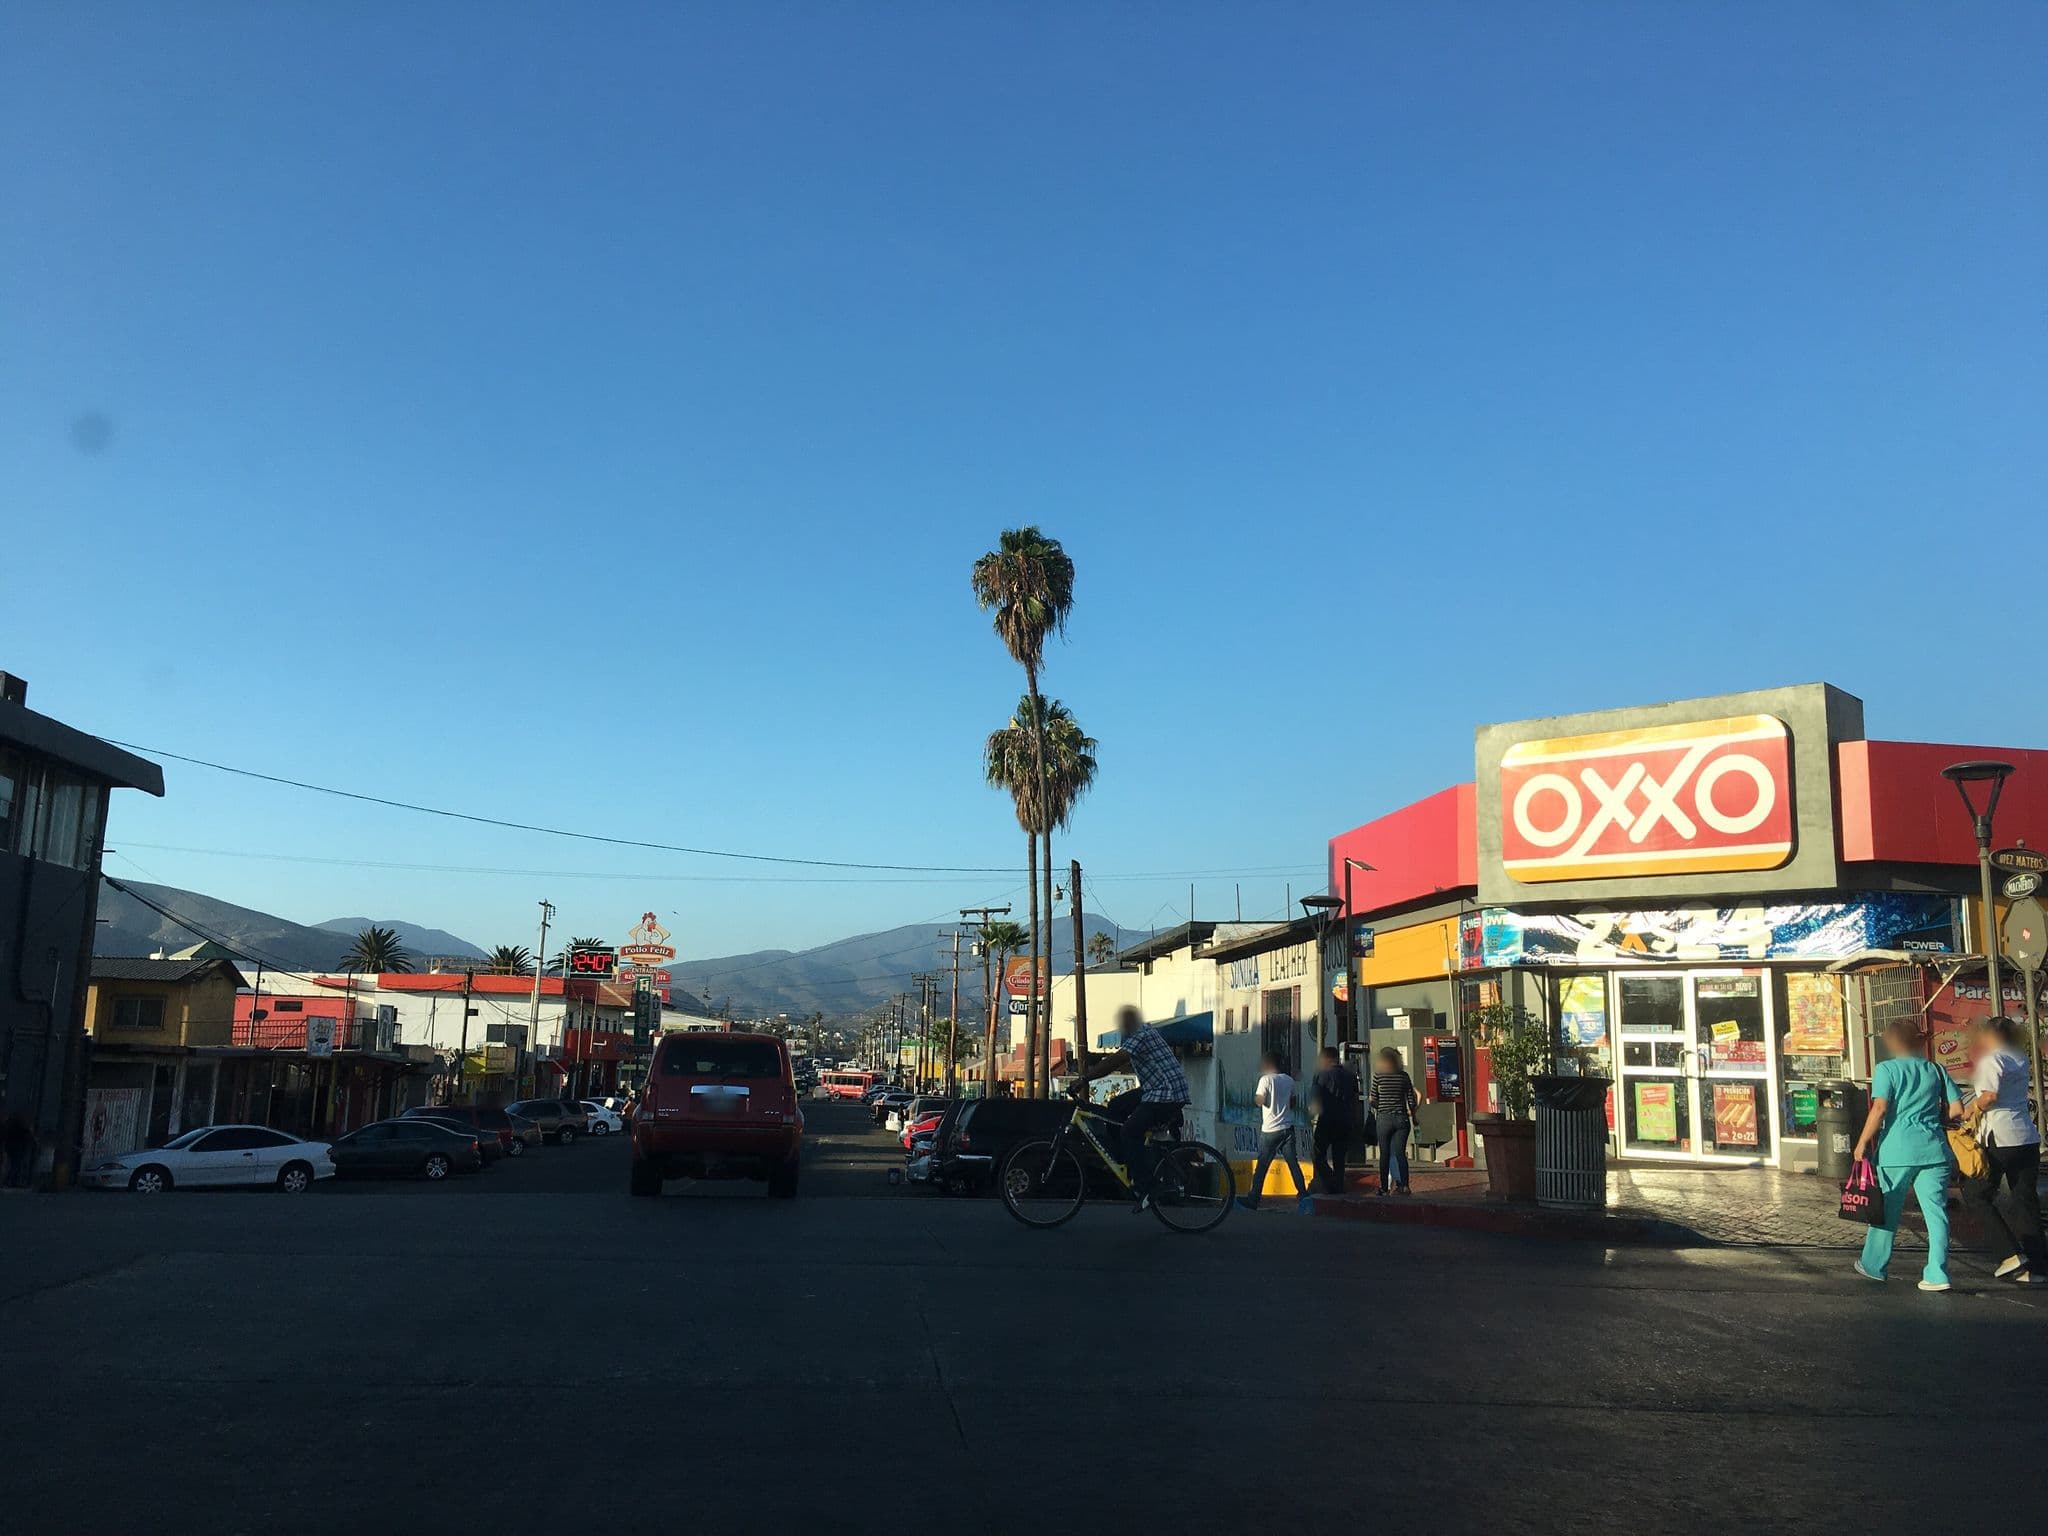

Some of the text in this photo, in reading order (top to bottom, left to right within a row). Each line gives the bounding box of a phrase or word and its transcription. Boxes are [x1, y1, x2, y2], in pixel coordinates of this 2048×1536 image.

[1513, 745, 1776, 856] OXXO
[2016, 855, 2043, 869] MATEOS
[625, 946, 670, 956] Pollo Feliz
[1902, 940, 1945, 950] POWER
[1269, 943, 1308, 982] LEATHER
[639, 980, 650, 1039] HOTEL
